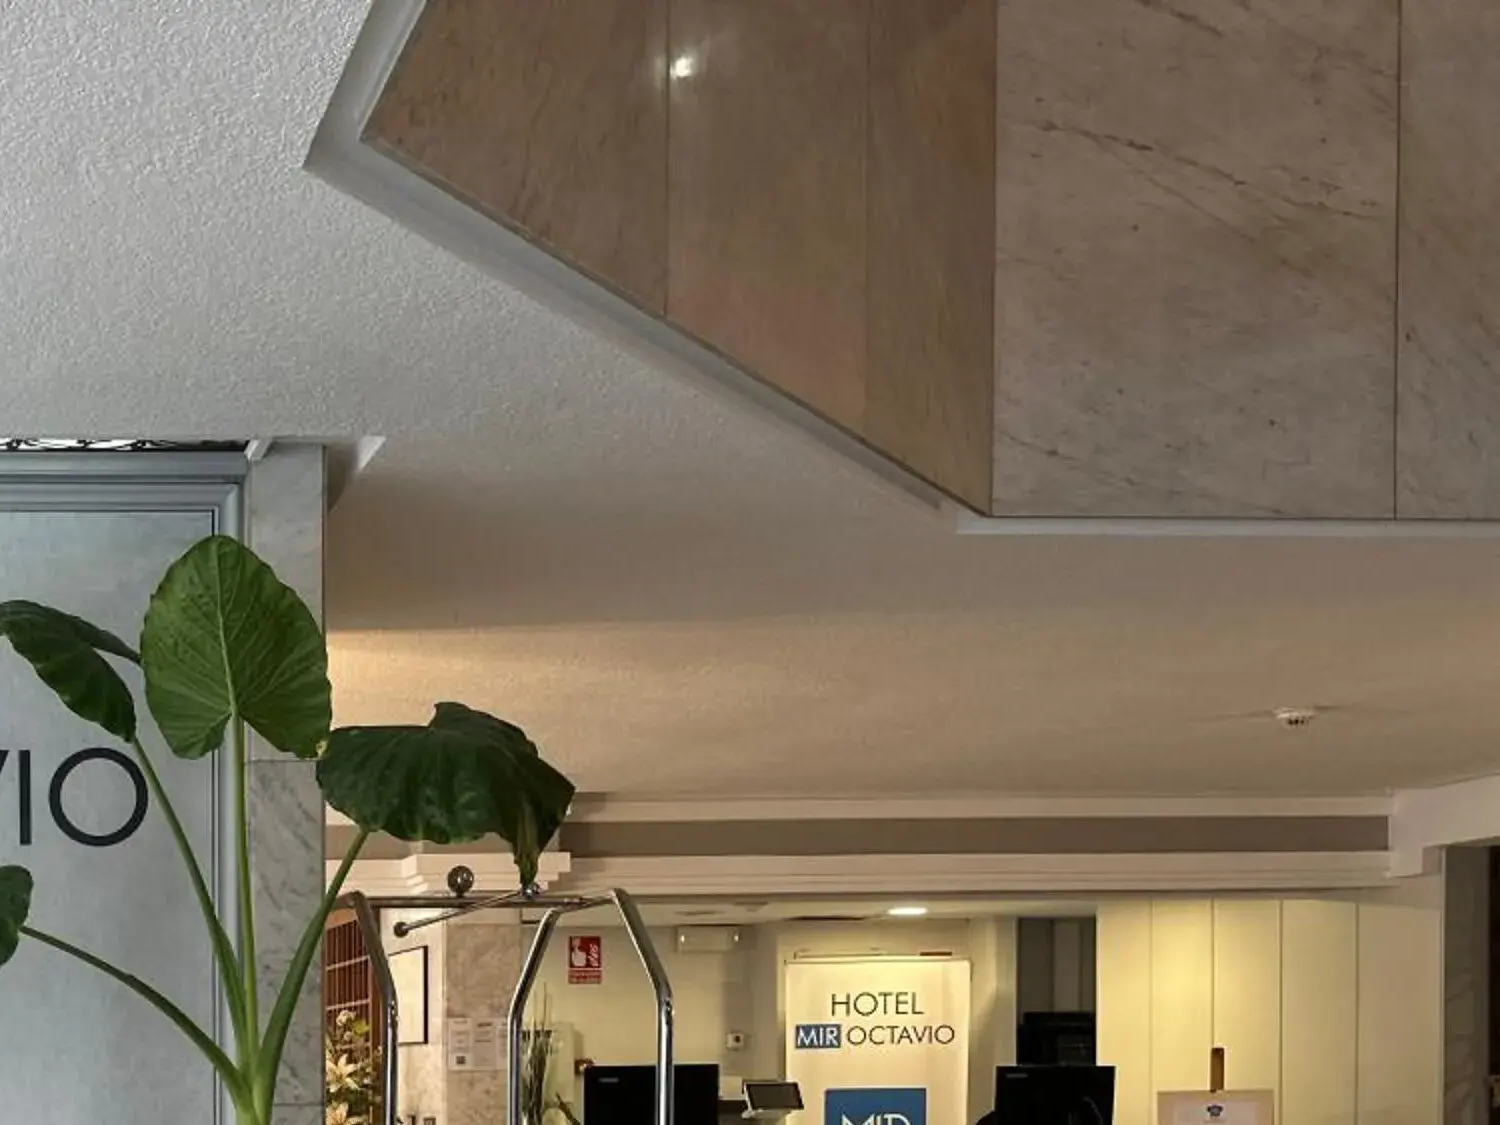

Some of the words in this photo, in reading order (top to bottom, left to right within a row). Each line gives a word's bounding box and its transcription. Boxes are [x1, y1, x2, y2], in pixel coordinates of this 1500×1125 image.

[831, 991, 924, 1017] HOTEL
[797, 1026, 839, 1046] MIR
[846, 1024, 955, 1046] OCTAVIO
